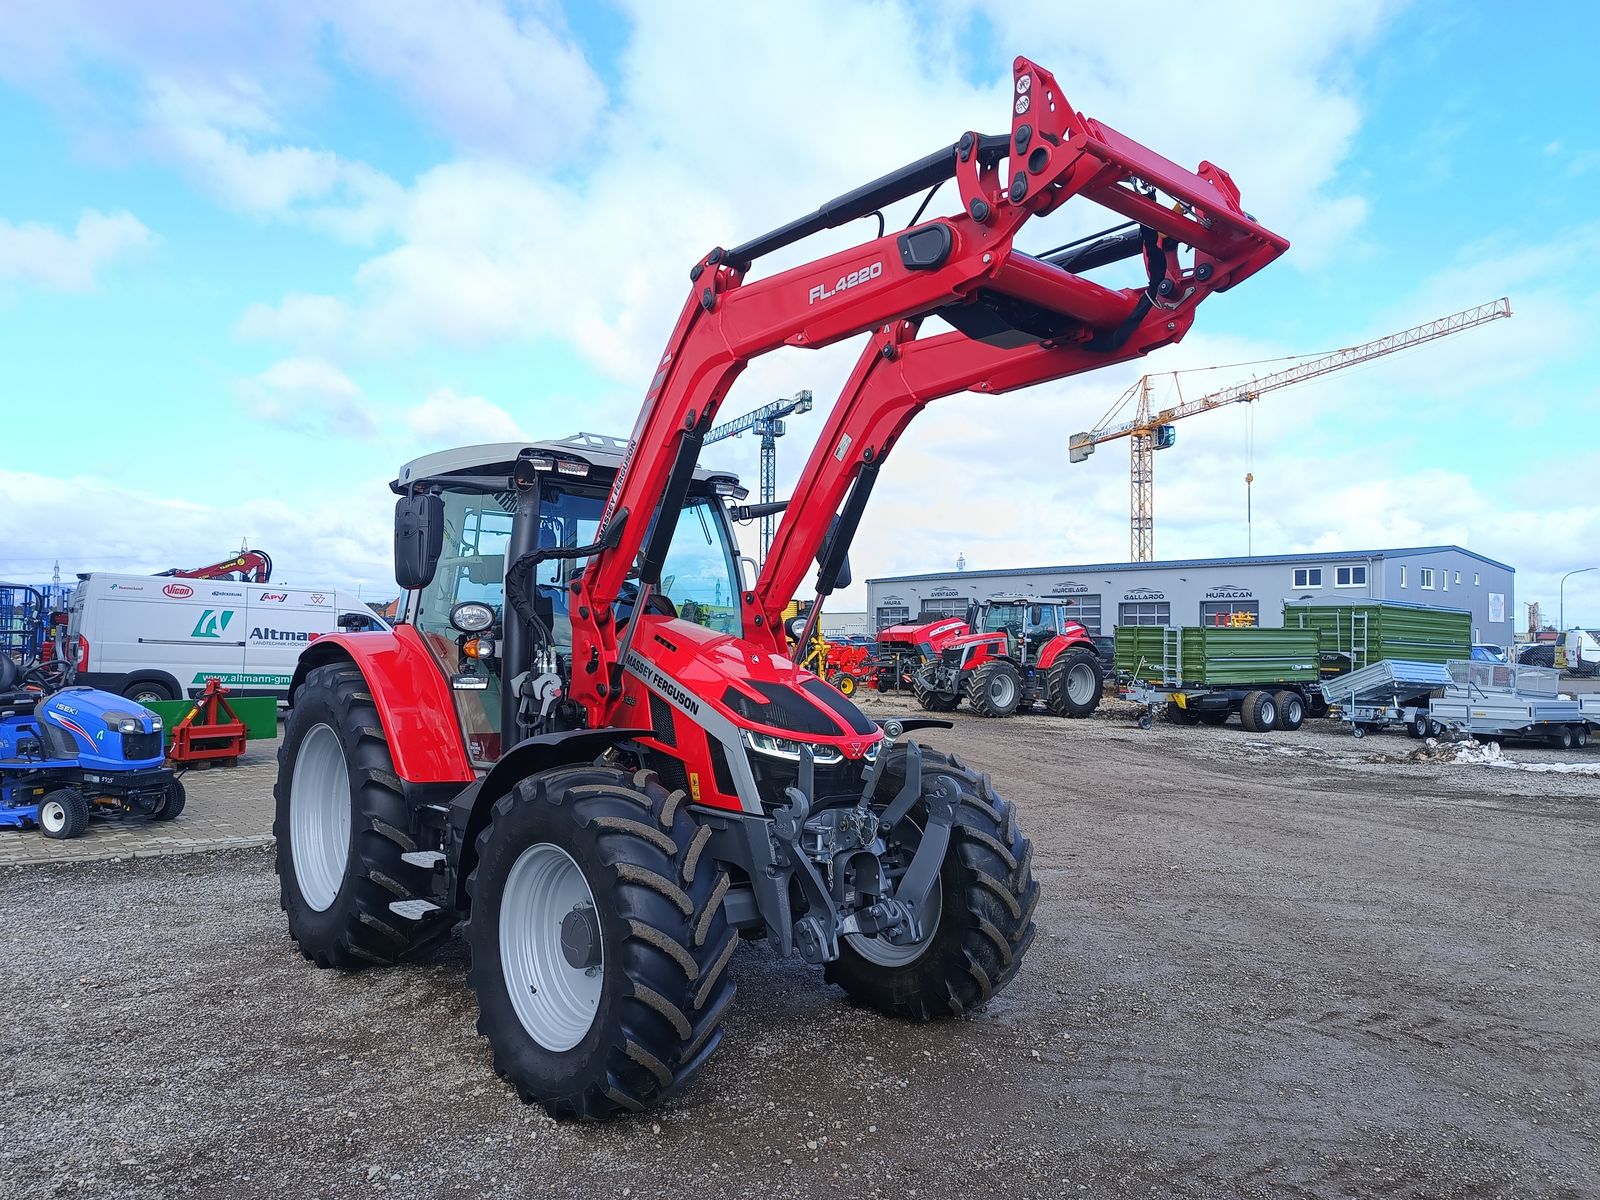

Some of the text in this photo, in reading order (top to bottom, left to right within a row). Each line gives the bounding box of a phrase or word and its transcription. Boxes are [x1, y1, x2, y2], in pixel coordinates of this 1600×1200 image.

[809, 261, 882, 305] FL.4220
[598, 441, 636, 540] MASSEY FERGUSON
[167, 585, 190, 595] Vicon
[626, 654, 699, 715] MASSEY FERGUSON
[56, 703, 78, 715] ISEKI
